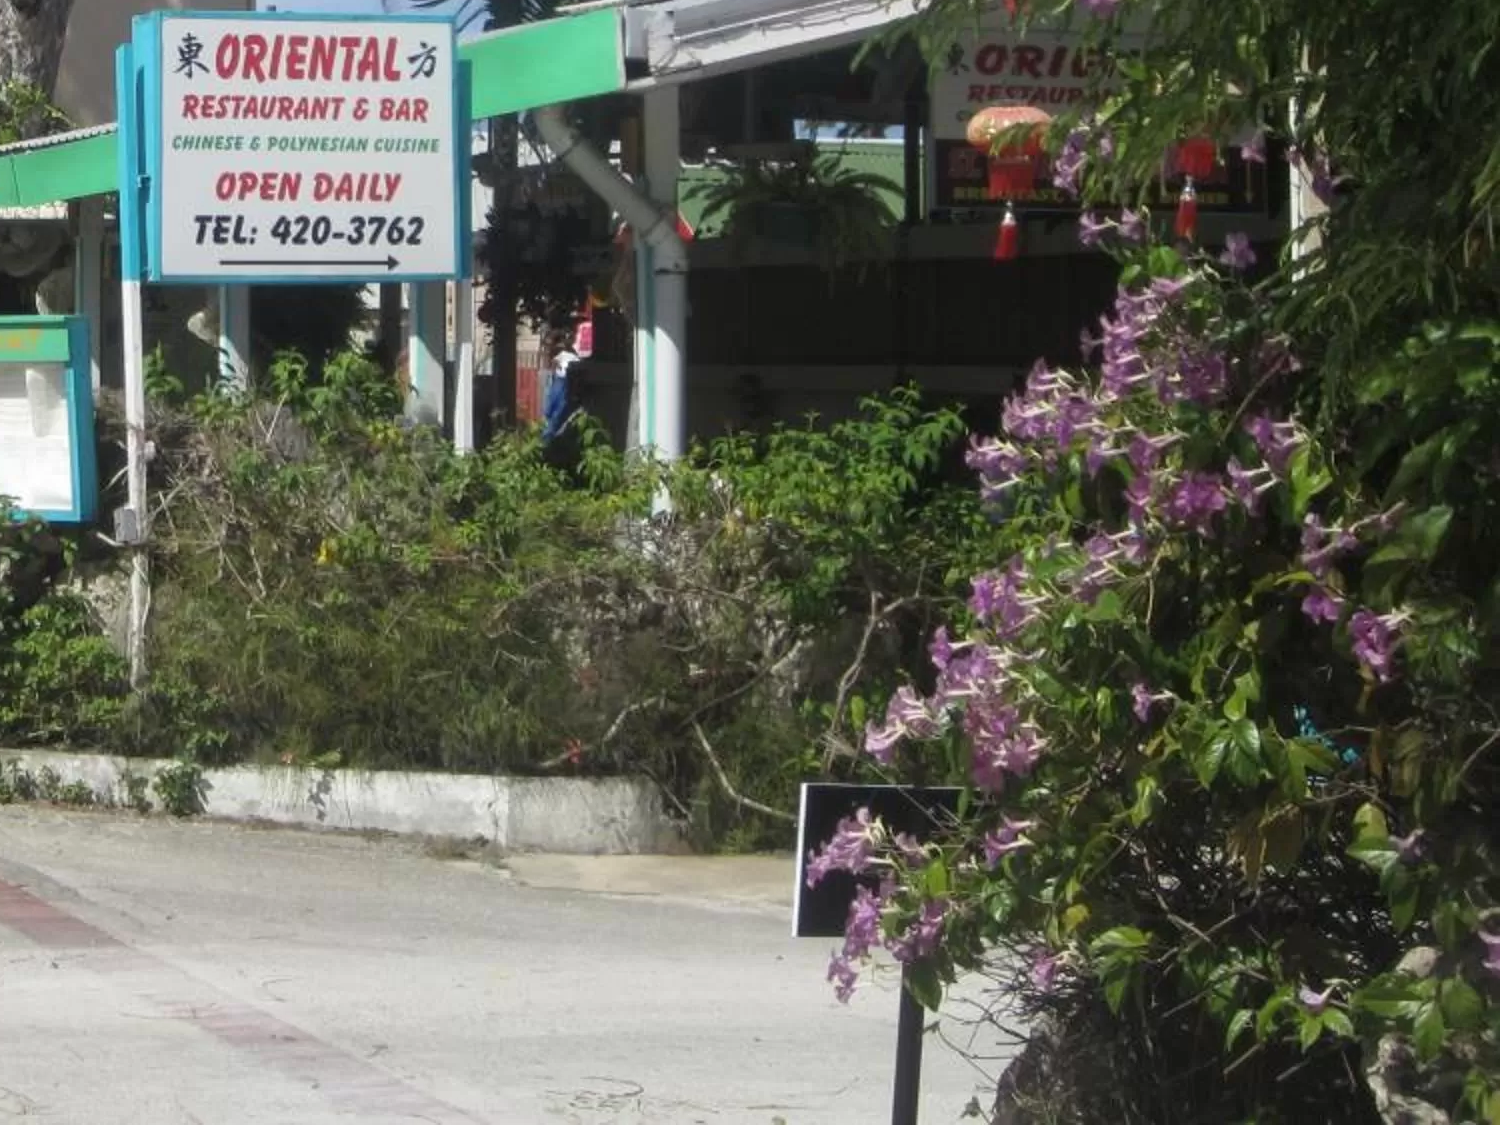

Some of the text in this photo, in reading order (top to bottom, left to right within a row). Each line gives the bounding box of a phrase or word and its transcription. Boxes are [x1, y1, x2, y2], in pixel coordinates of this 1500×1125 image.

[173, 32, 210, 79] 東
[215, 33, 402, 84] ORIENTAL
[407, 42, 437, 79] 方
[182, 95, 429, 123] RESTAURANT & BAR
[172, 135, 440, 153] CHINESE & POLYNESIAN CUISINE
[215, 172, 402, 202] OPEN DAILY
[194, 215, 425, 245] TEL: 420-3762
